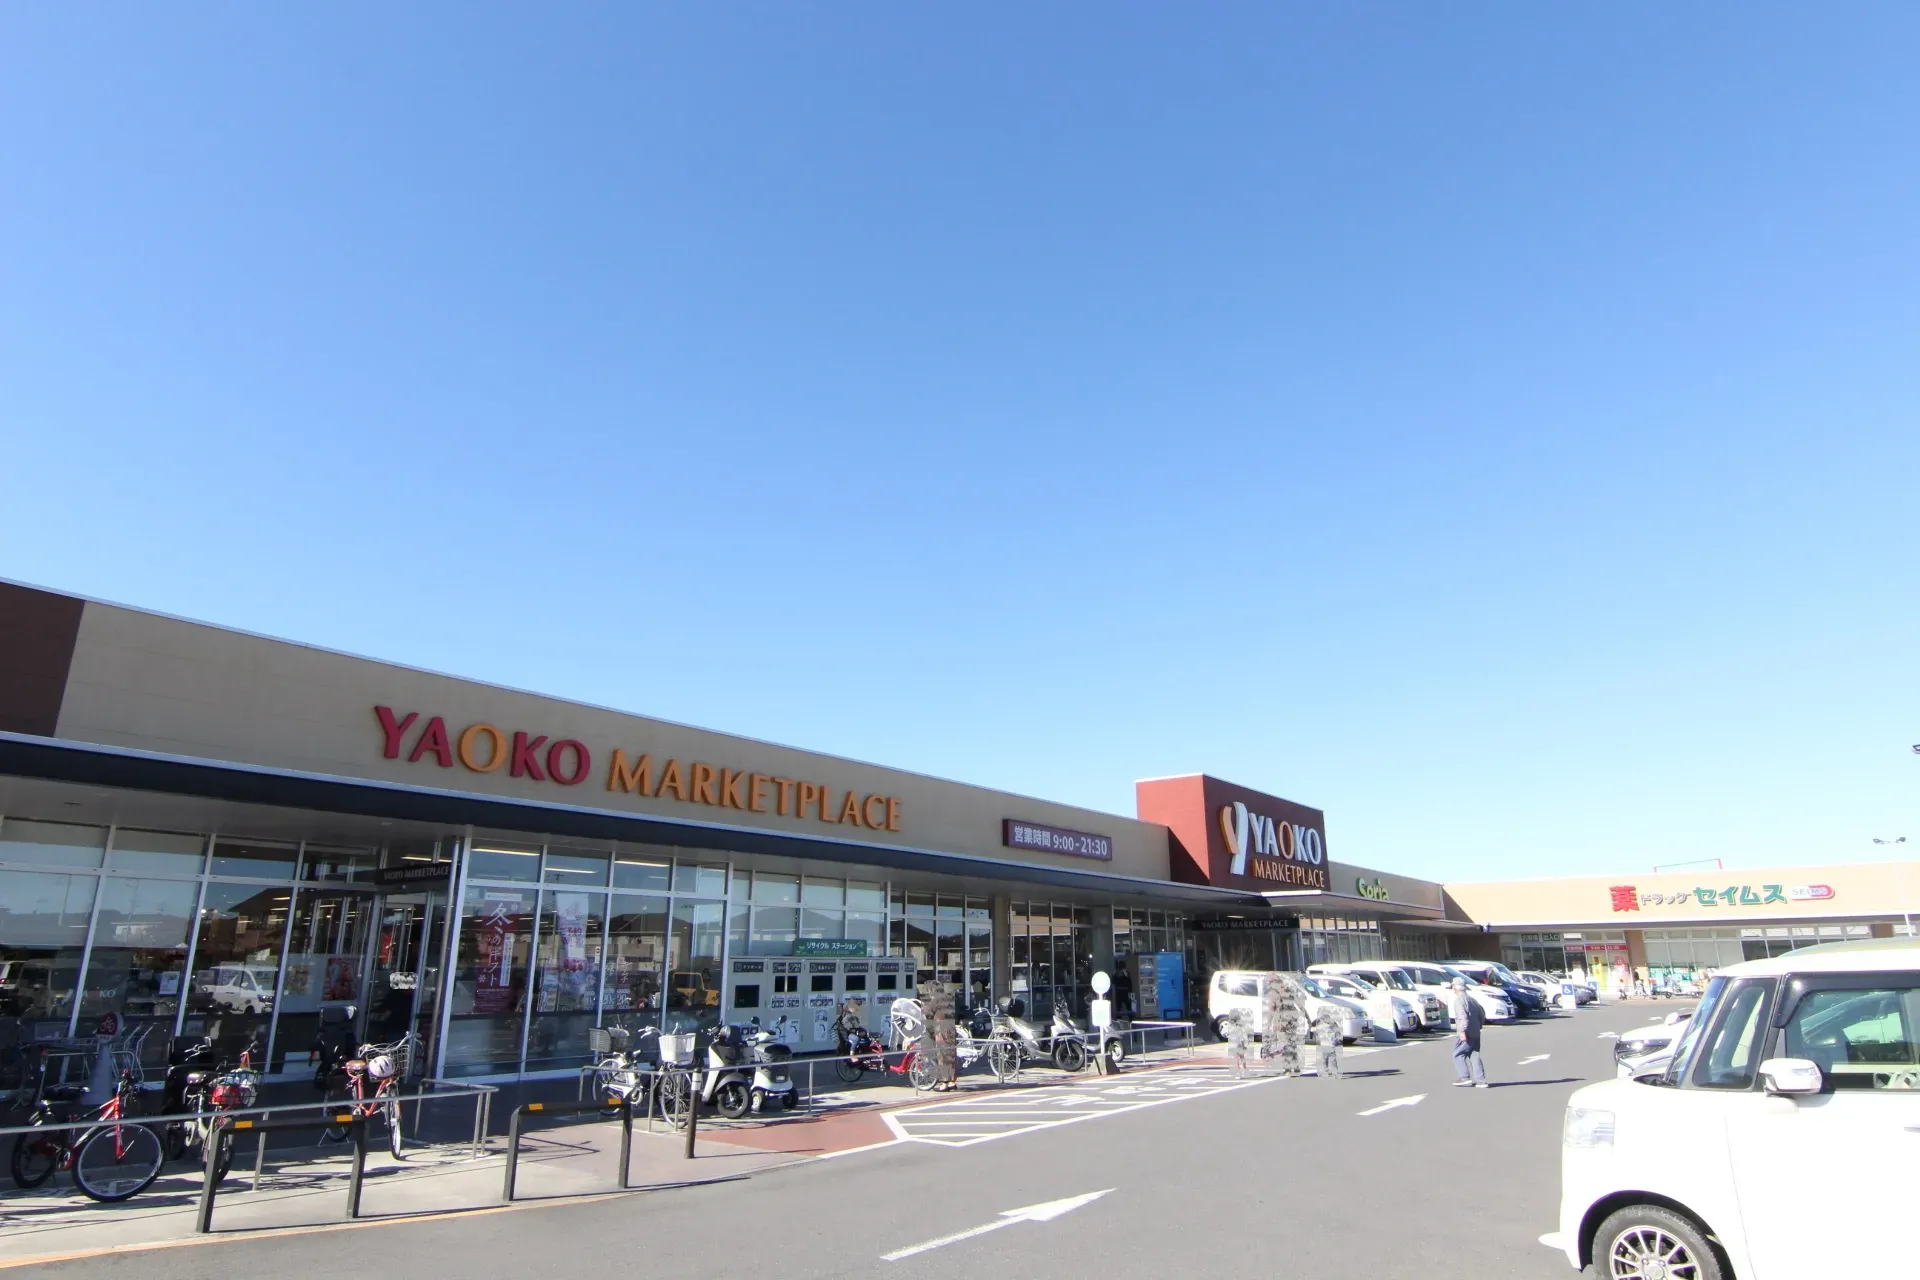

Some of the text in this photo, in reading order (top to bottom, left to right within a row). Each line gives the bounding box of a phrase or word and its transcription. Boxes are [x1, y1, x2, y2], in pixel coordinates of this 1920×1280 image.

[374, 705, 903, 832] YAOKO MARKETPLACE
[1014, 825, 1051, 848] 営業時間
[1248, 812, 1322, 865] YAOKO
[1252, 858, 1325, 888] MARKETPLACE
[1608, 885, 1640, 912] 薬
[1693, 884, 1788, 907] セイムス
